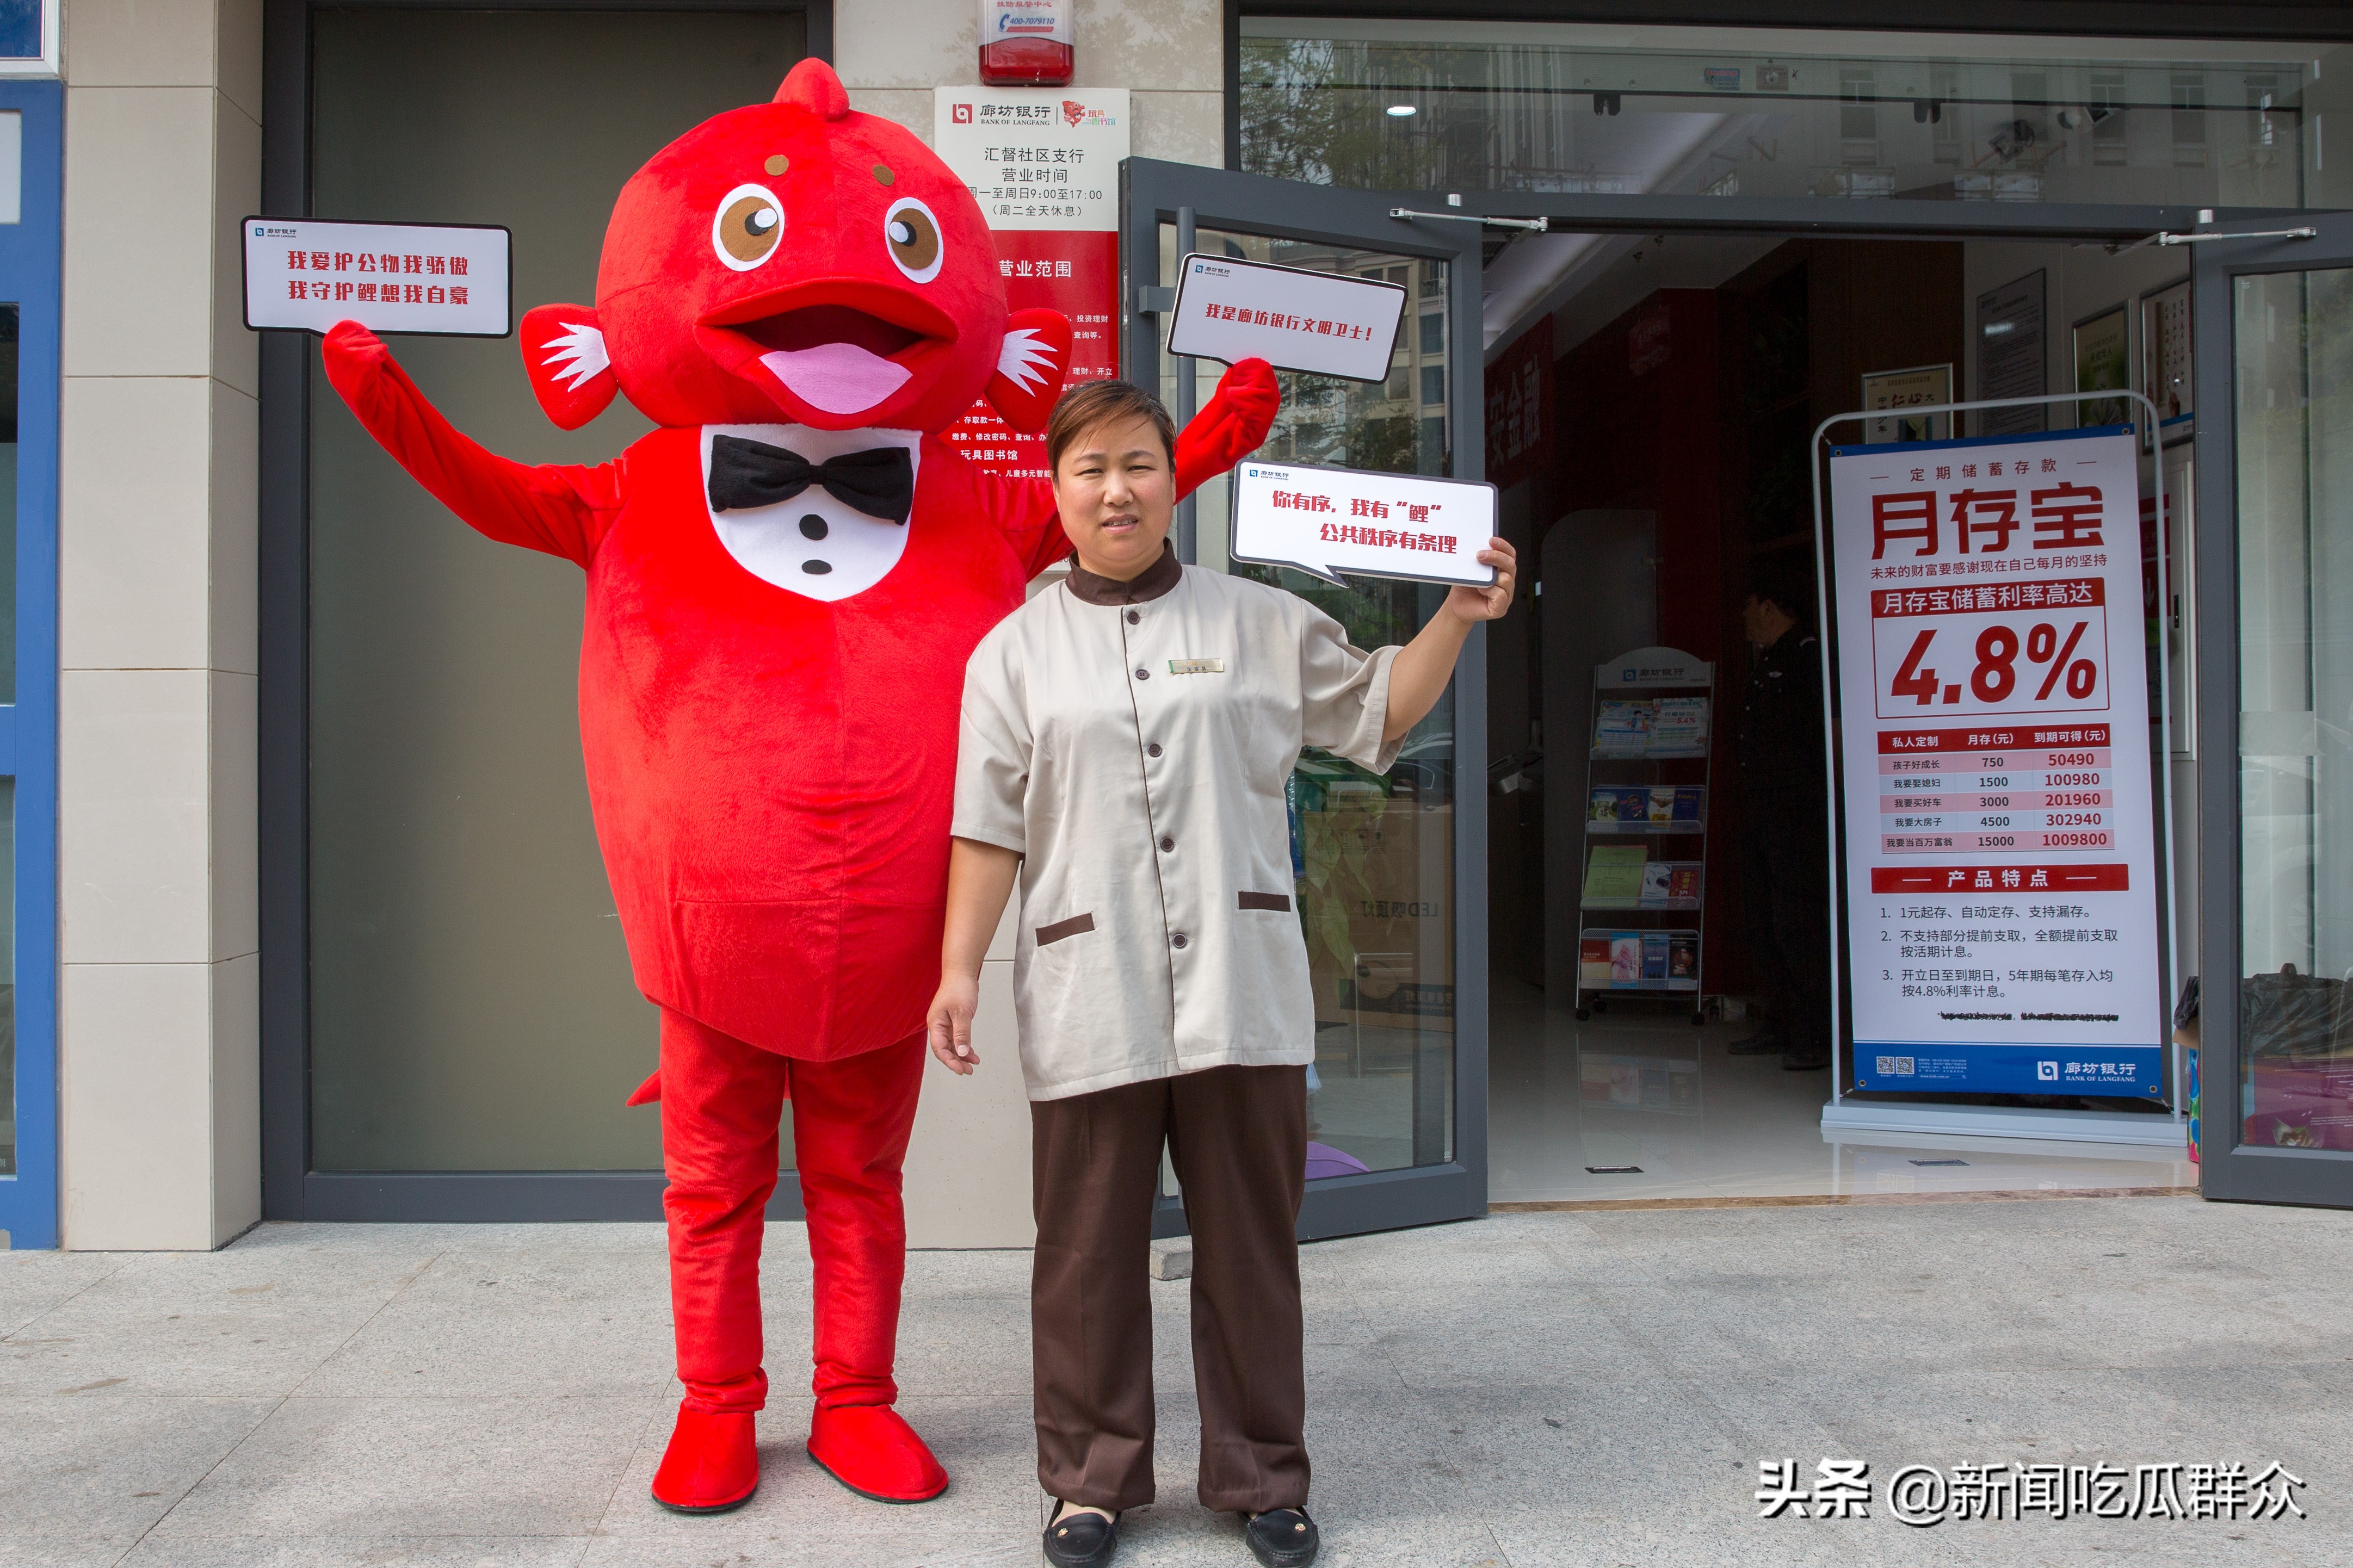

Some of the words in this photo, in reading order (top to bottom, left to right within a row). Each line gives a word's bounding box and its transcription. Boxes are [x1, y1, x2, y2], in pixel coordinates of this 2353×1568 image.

[980, 104, 1051, 118] 廊坊银行
[1092, 117, 1116, 126] 图书馆
[984, 147, 1084, 163] 汇督社区支行
[1002, 168, 1068, 182] 营业时间
[287, 250, 468, 276] 我爱护公物我骄傲
[999, 260, 1071, 277] 营业范围
[1205, 267, 1230, 275] 廊坊银行
[288, 281, 468, 305] 我守护鲤想我自豪
[1064, 314, 1108, 323] 、投资理财
[1205, 303, 1372, 341] 我是廊坊银行文明卫士！
[952, 433, 1048, 441] 缴费、修改密码、查询、办
[960, 449, 1018, 460] 玩具图书馆
[1910, 458, 2056, 482] 定期储蓄存款
[1870, 481, 2105, 561] 月存宝
[1320, 523, 1457, 554] 公共秩序有条理
[1870, 553, 2108, 580] 未来的财富要感谢现在自己每月的坚持
[1883, 581, 2093, 615] 月存宝储蓄利率高达
[1891, 621, 2097, 706] 4.8%
[1639, 668, 1684, 677] 廊坊银行
[1892, 736, 1938, 748] 私人定制
[1968, 733, 2014, 746] 月存(元)
[2034, 729, 2107, 743] 到期可得(元)
[1892, 759, 1940, 771] 孩子好成长
[1982, 757, 2004, 768] 750
[2048, 753, 2095, 766] 50490
[1893, 778, 1941, 789] 我要娶媳妇
[1979, 777, 2008, 788] 1500
[2045, 772, 2100, 786] 100980
[1894, 797, 1941, 808] 我要买好车
[1980, 796, 2009, 807] 3000
[2045, 792, 2101, 807] 201960
[1894, 817, 1942, 827] 我要大房子
[1980, 816, 2010, 827] 4500
[2046, 813, 2102, 827] 302940
[1886, 837, 1953, 848] 我要当百万富翁
[1978, 836, 2014, 847] 15000
[2042, 833, 2107, 847] 1009800
[1948, 869, 2048, 888] 产品特点
[1880, 907, 1891, 919] 1.
[1900, 906, 2090, 920] 1元起存、自动定存、支持漏存。
[1881, 931, 1892, 942] 2.
[1900, 929, 2118, 944] 不支持部分提前支取，全额提前支取
[1900, 945, 1973, 959] 按活期计息。
[1882, 969, 1893, 981] 3.
[1901, 969, 2113, 982] 开立日至到期日，5年期每笔存入均
[1901, 984, 2005, 998] 按4.8%利率计息。
[2064, 1062, 2136, 1075] 廊坊银行
